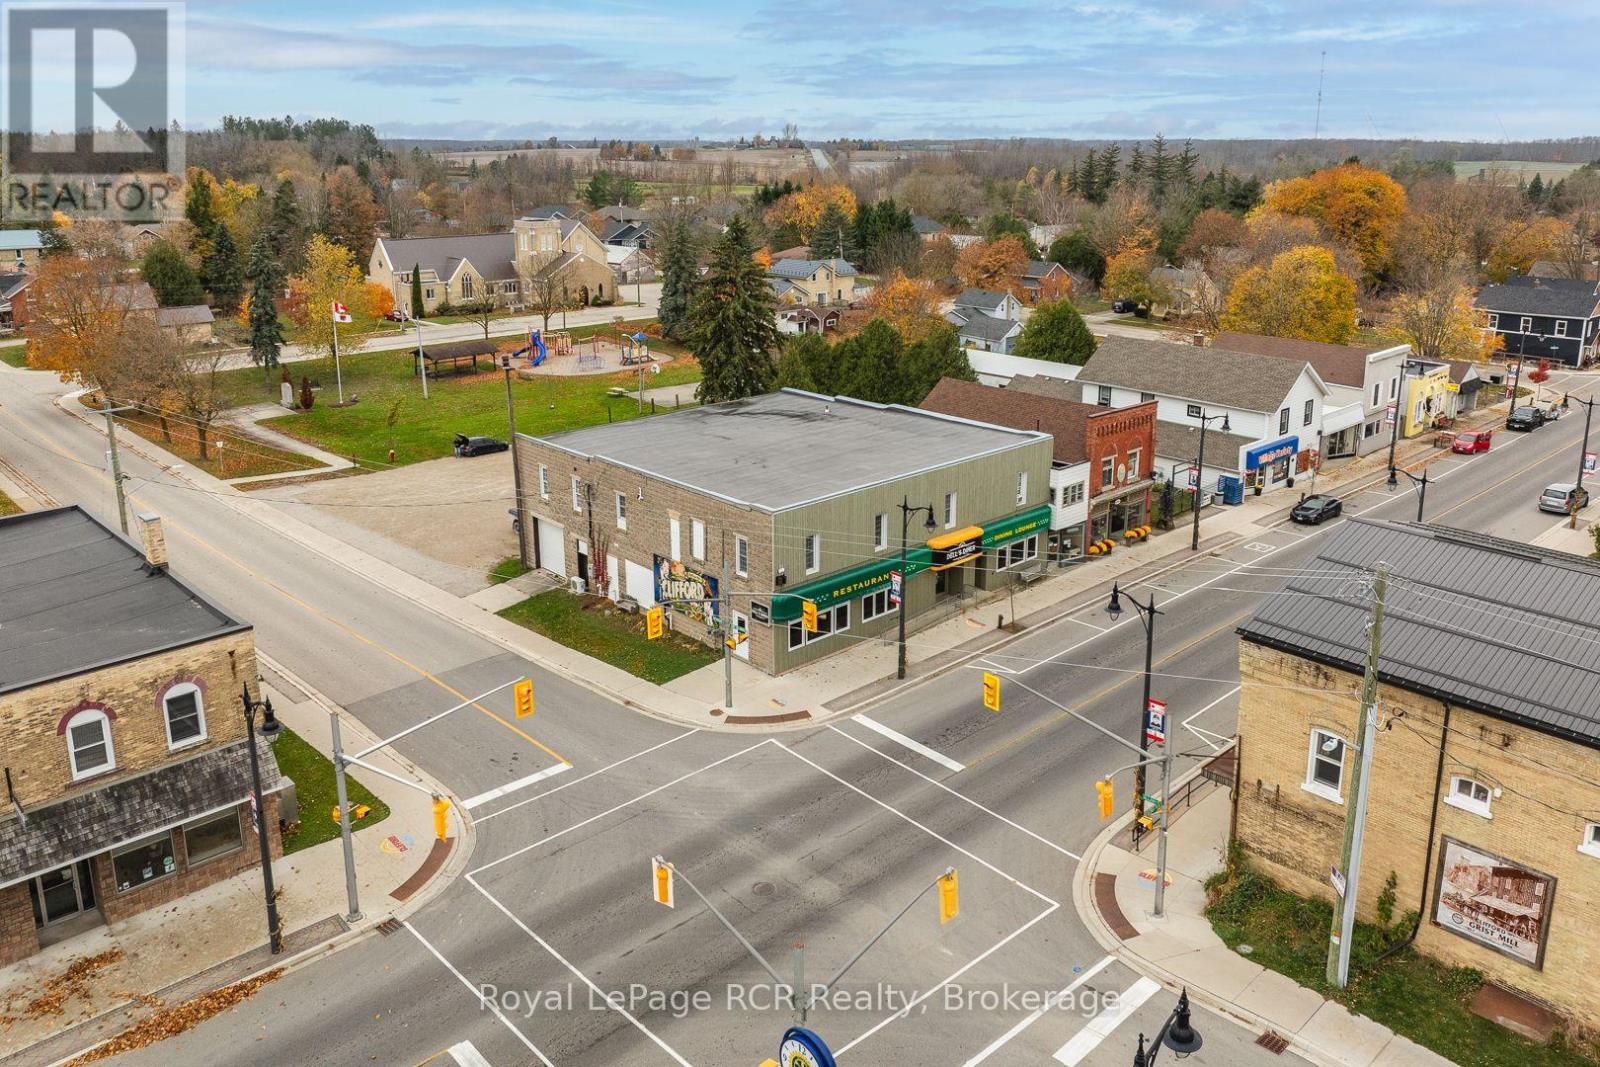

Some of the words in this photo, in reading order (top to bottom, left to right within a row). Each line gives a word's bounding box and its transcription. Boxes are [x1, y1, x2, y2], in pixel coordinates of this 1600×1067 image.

[661, 580, 705, 600] CLIFFORD
[832, 572, 891, 598] RESTAURAN
[1469, 921, 1495, 937] GRIST
[1498, 933, 1519, 949] MILL
